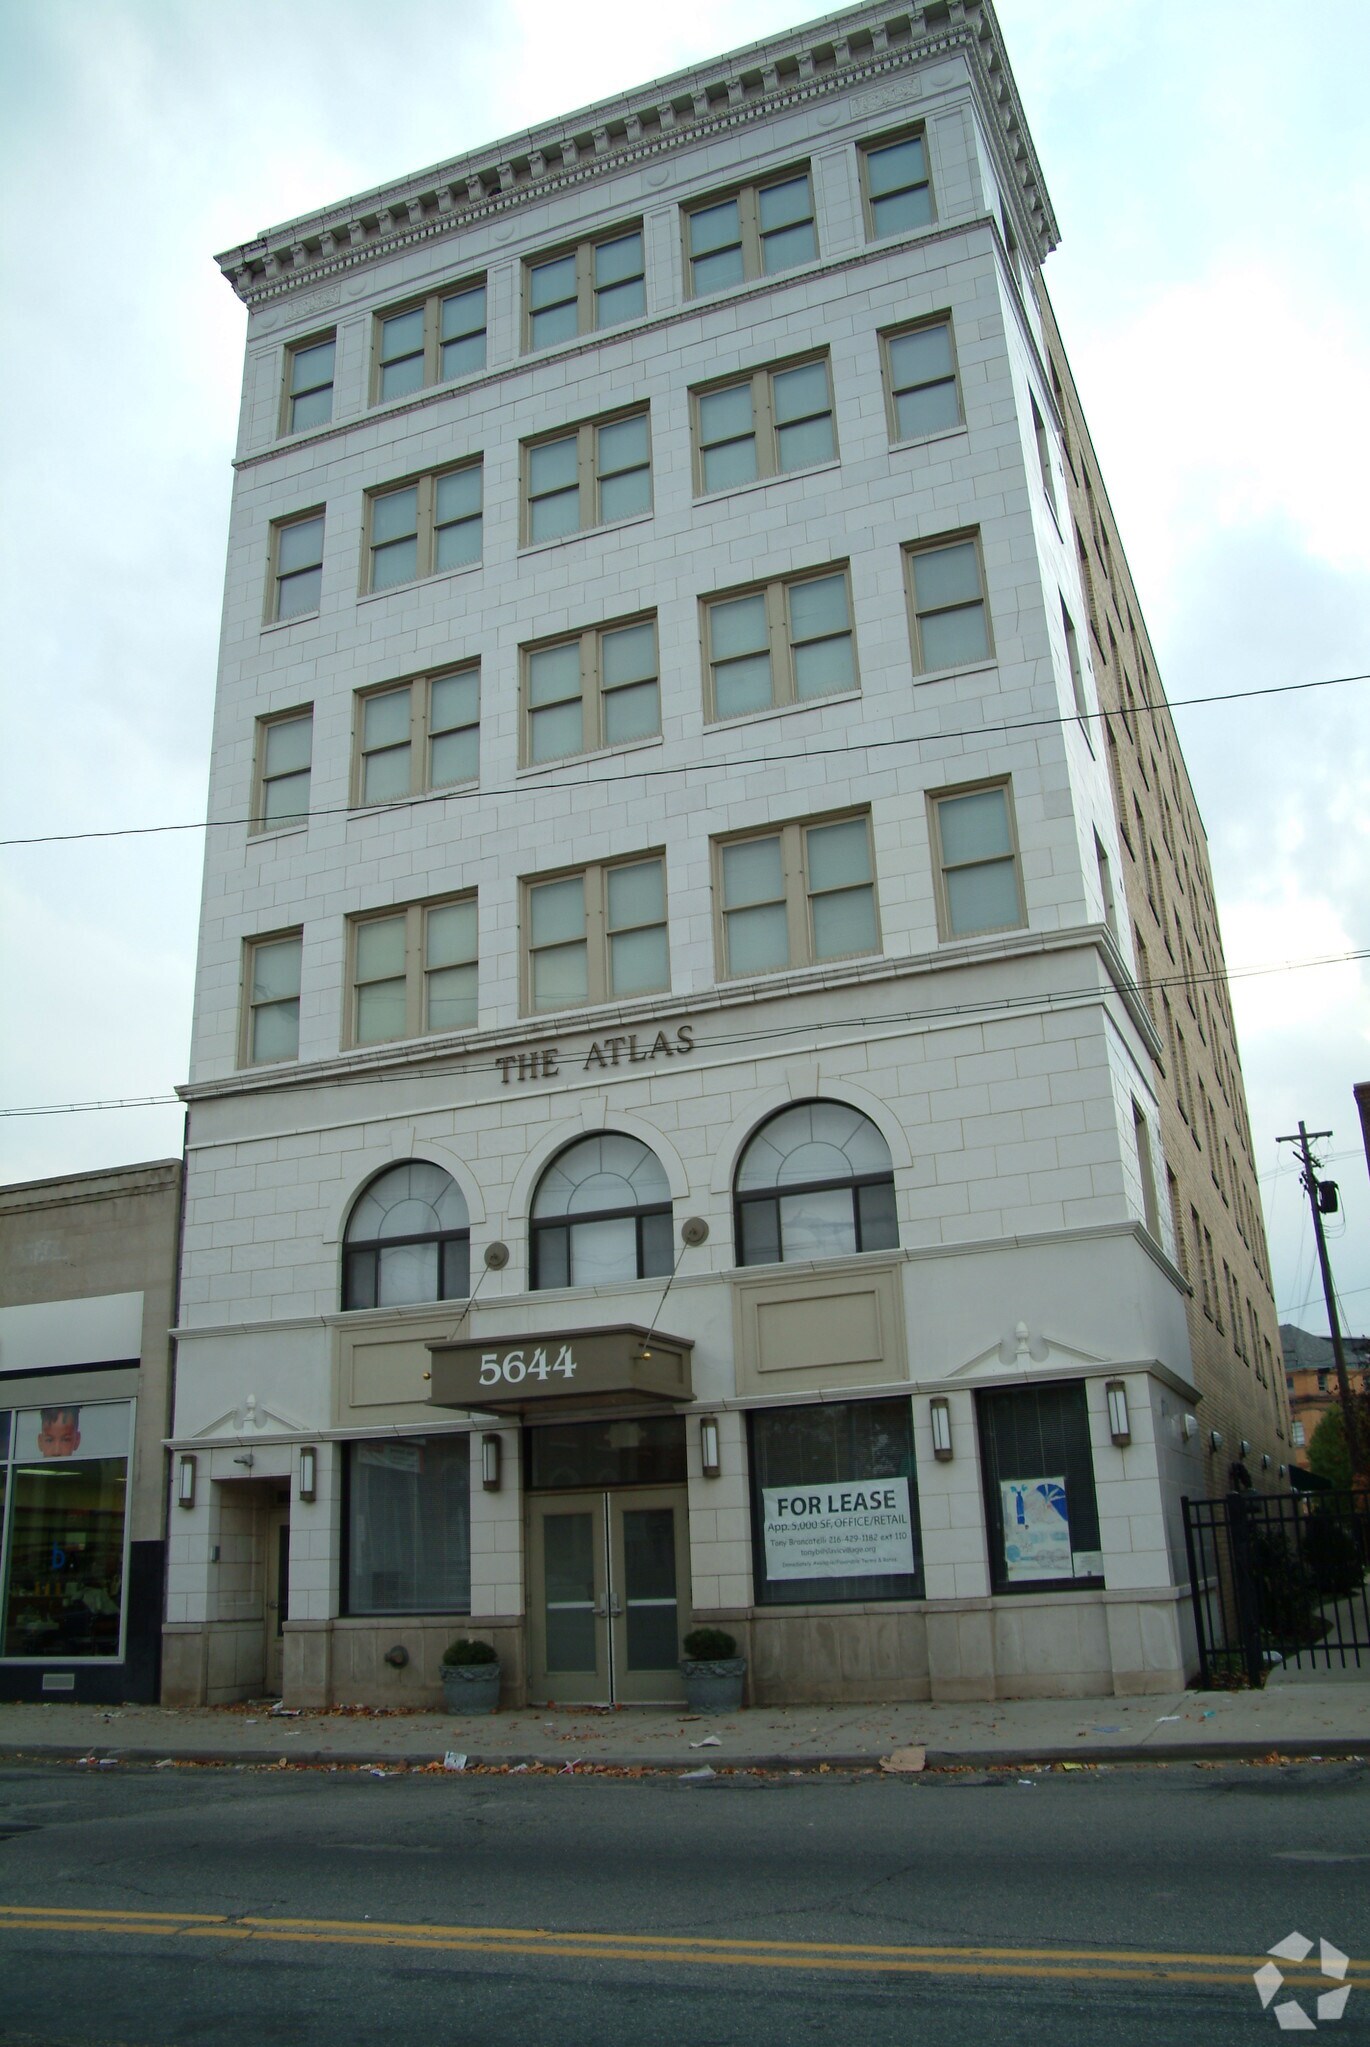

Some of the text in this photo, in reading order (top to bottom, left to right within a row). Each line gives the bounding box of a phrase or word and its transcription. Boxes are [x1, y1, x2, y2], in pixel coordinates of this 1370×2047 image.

[495, 1025, 695, 1083] THE ATLAS
[479, 1345, 577, 1386] 5644
[777, 1489, 897, 1517] FOR LEASE
[767, 1522, 790, 1534] App.
[834, 1513, 908, 1528] OFFICE/RETAIL
[770, 1538, 787, 1548] Tony
